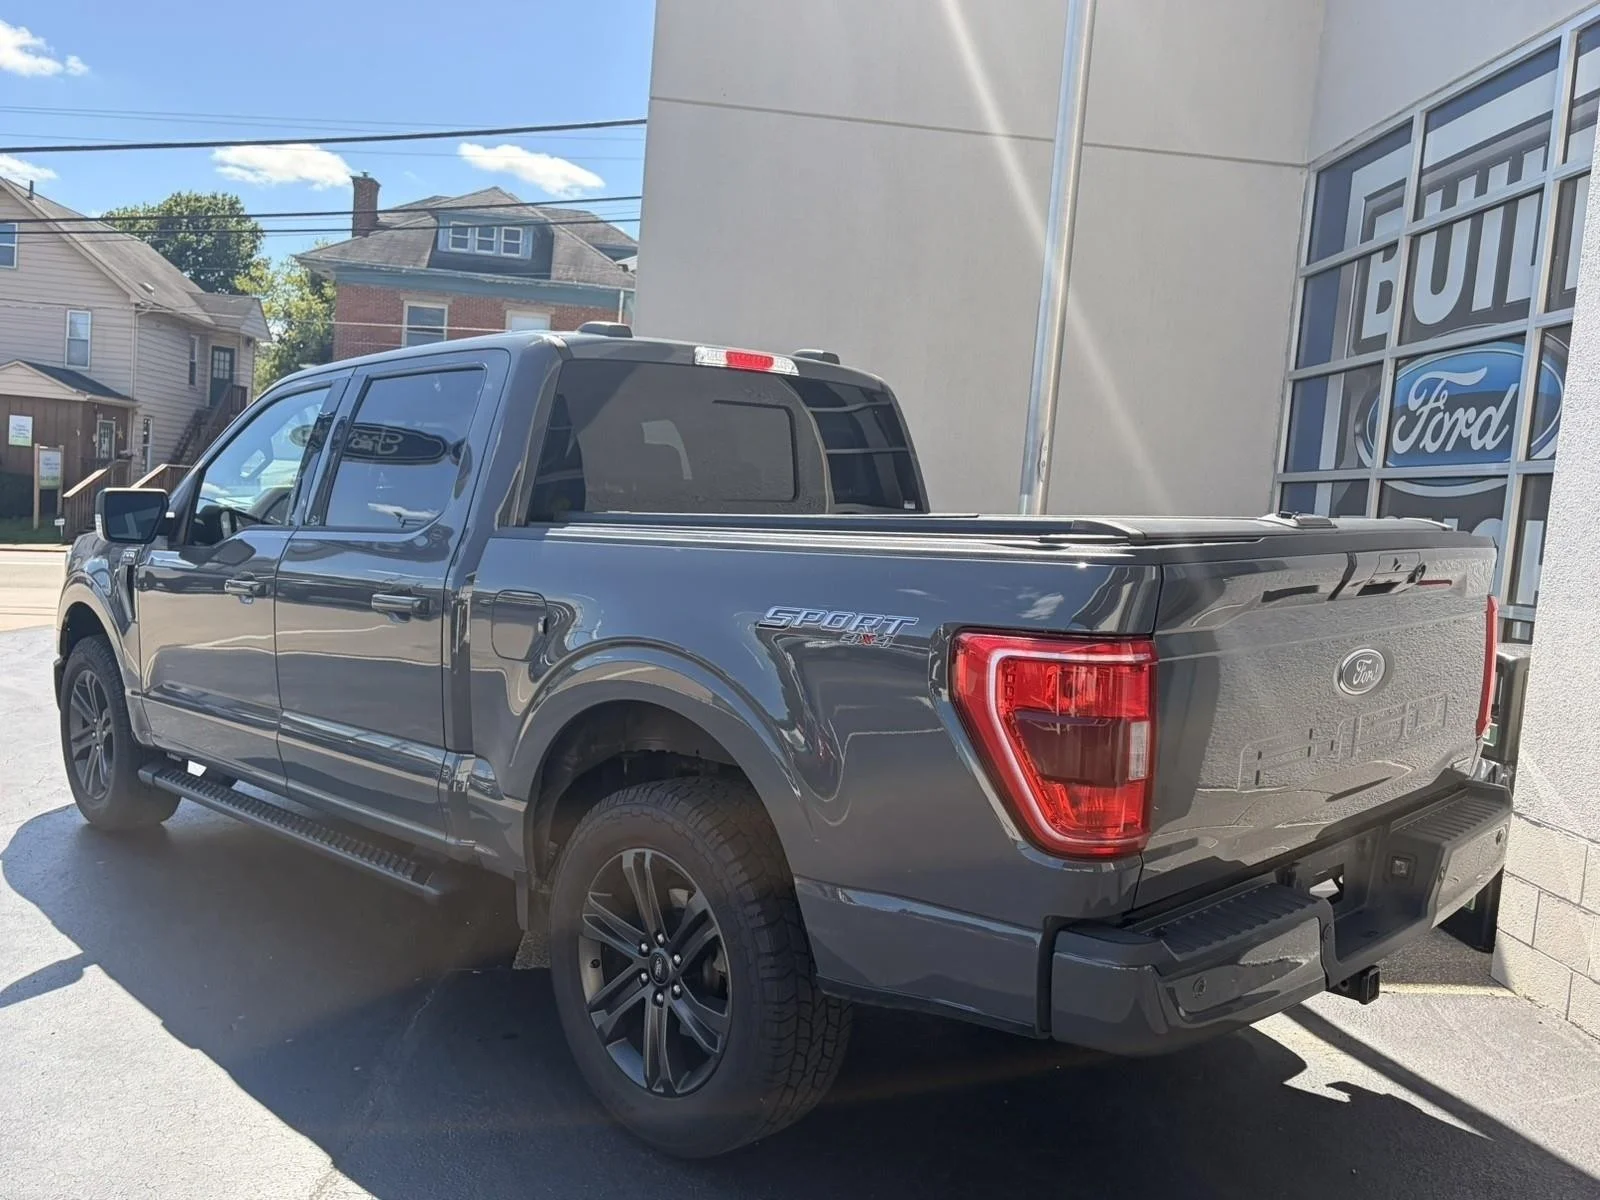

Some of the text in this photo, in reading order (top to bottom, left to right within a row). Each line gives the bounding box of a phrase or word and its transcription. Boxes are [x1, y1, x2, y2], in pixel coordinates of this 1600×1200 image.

[1392, 366, 1519, 455] Ford
[756, 605, 920, 637] SPORT
[1352, 658, 1379, 685] Ford
